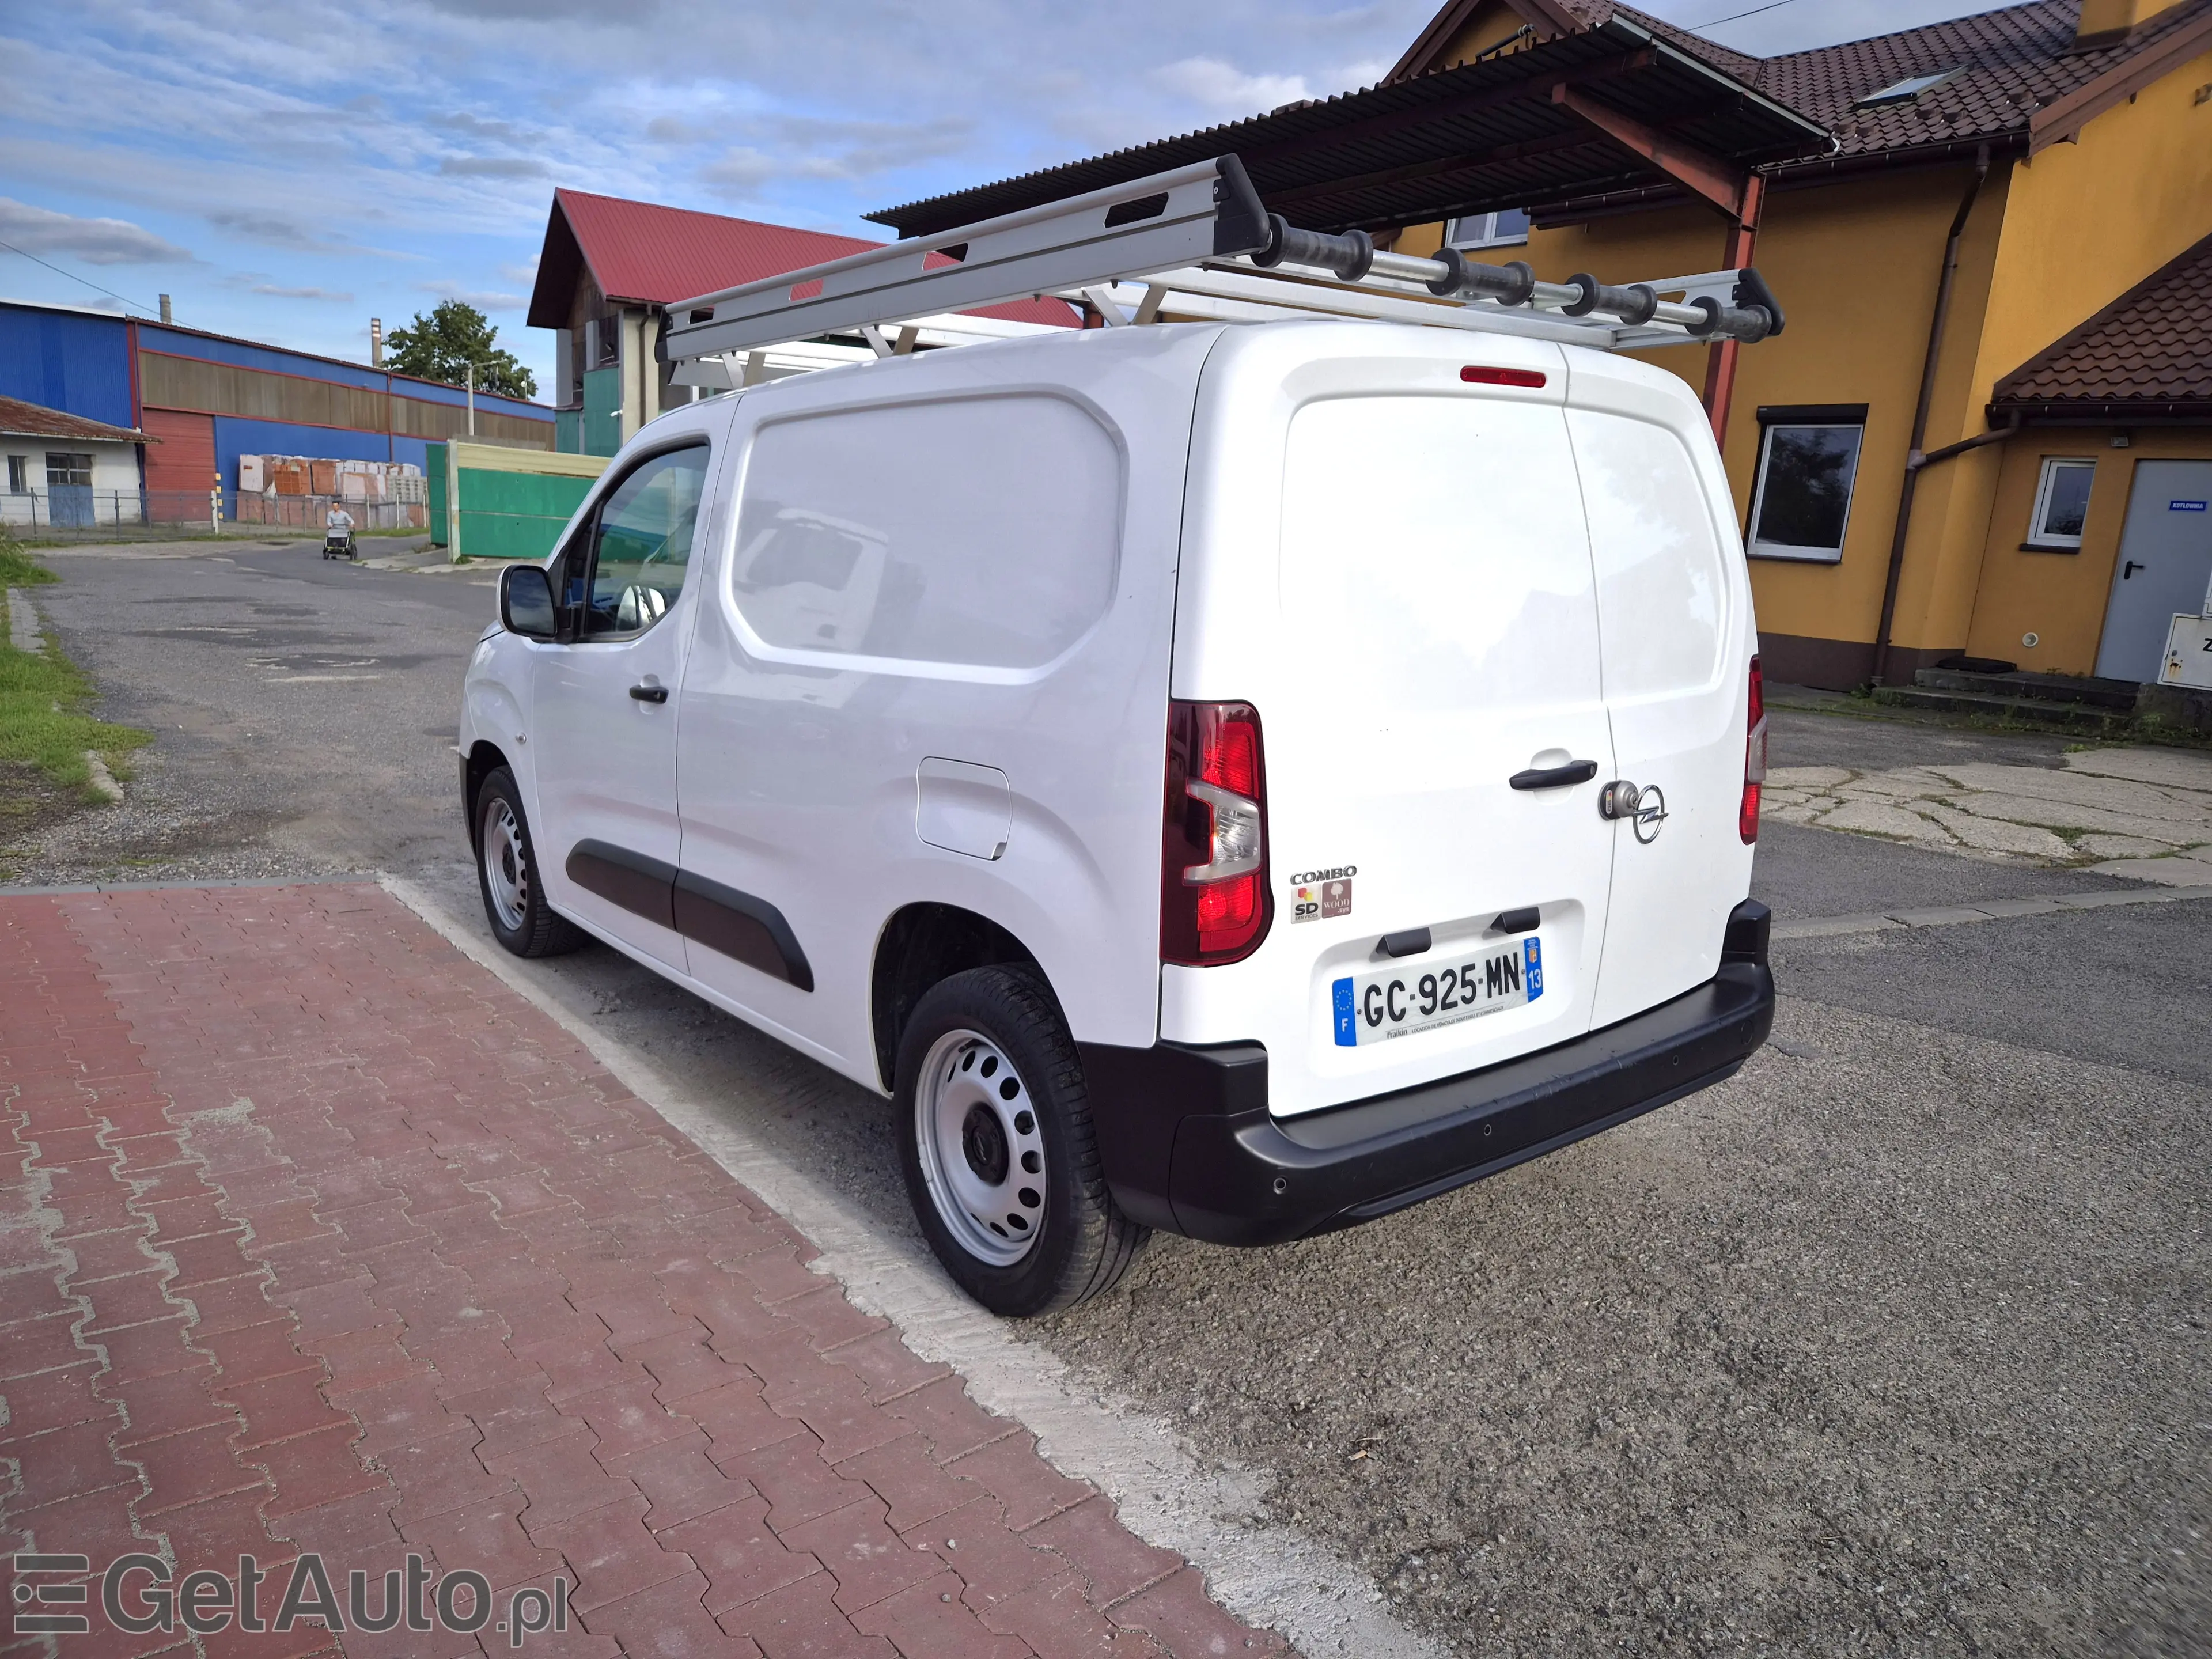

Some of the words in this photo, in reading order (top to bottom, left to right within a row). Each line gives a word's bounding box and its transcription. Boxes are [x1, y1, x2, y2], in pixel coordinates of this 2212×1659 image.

[1290, 865, 1357, 885] COMBO
[1295, 902, 1319, 916] SD
[1324, 899, 1350, 909] WOOD
[1528, 968, 1542, 990] 13
[1342, 1018, 1349, 1032] F
[1387, 1029, 1408, 1039] Fraikin
[1412, 1025, 1431, 1033] LOCATION
